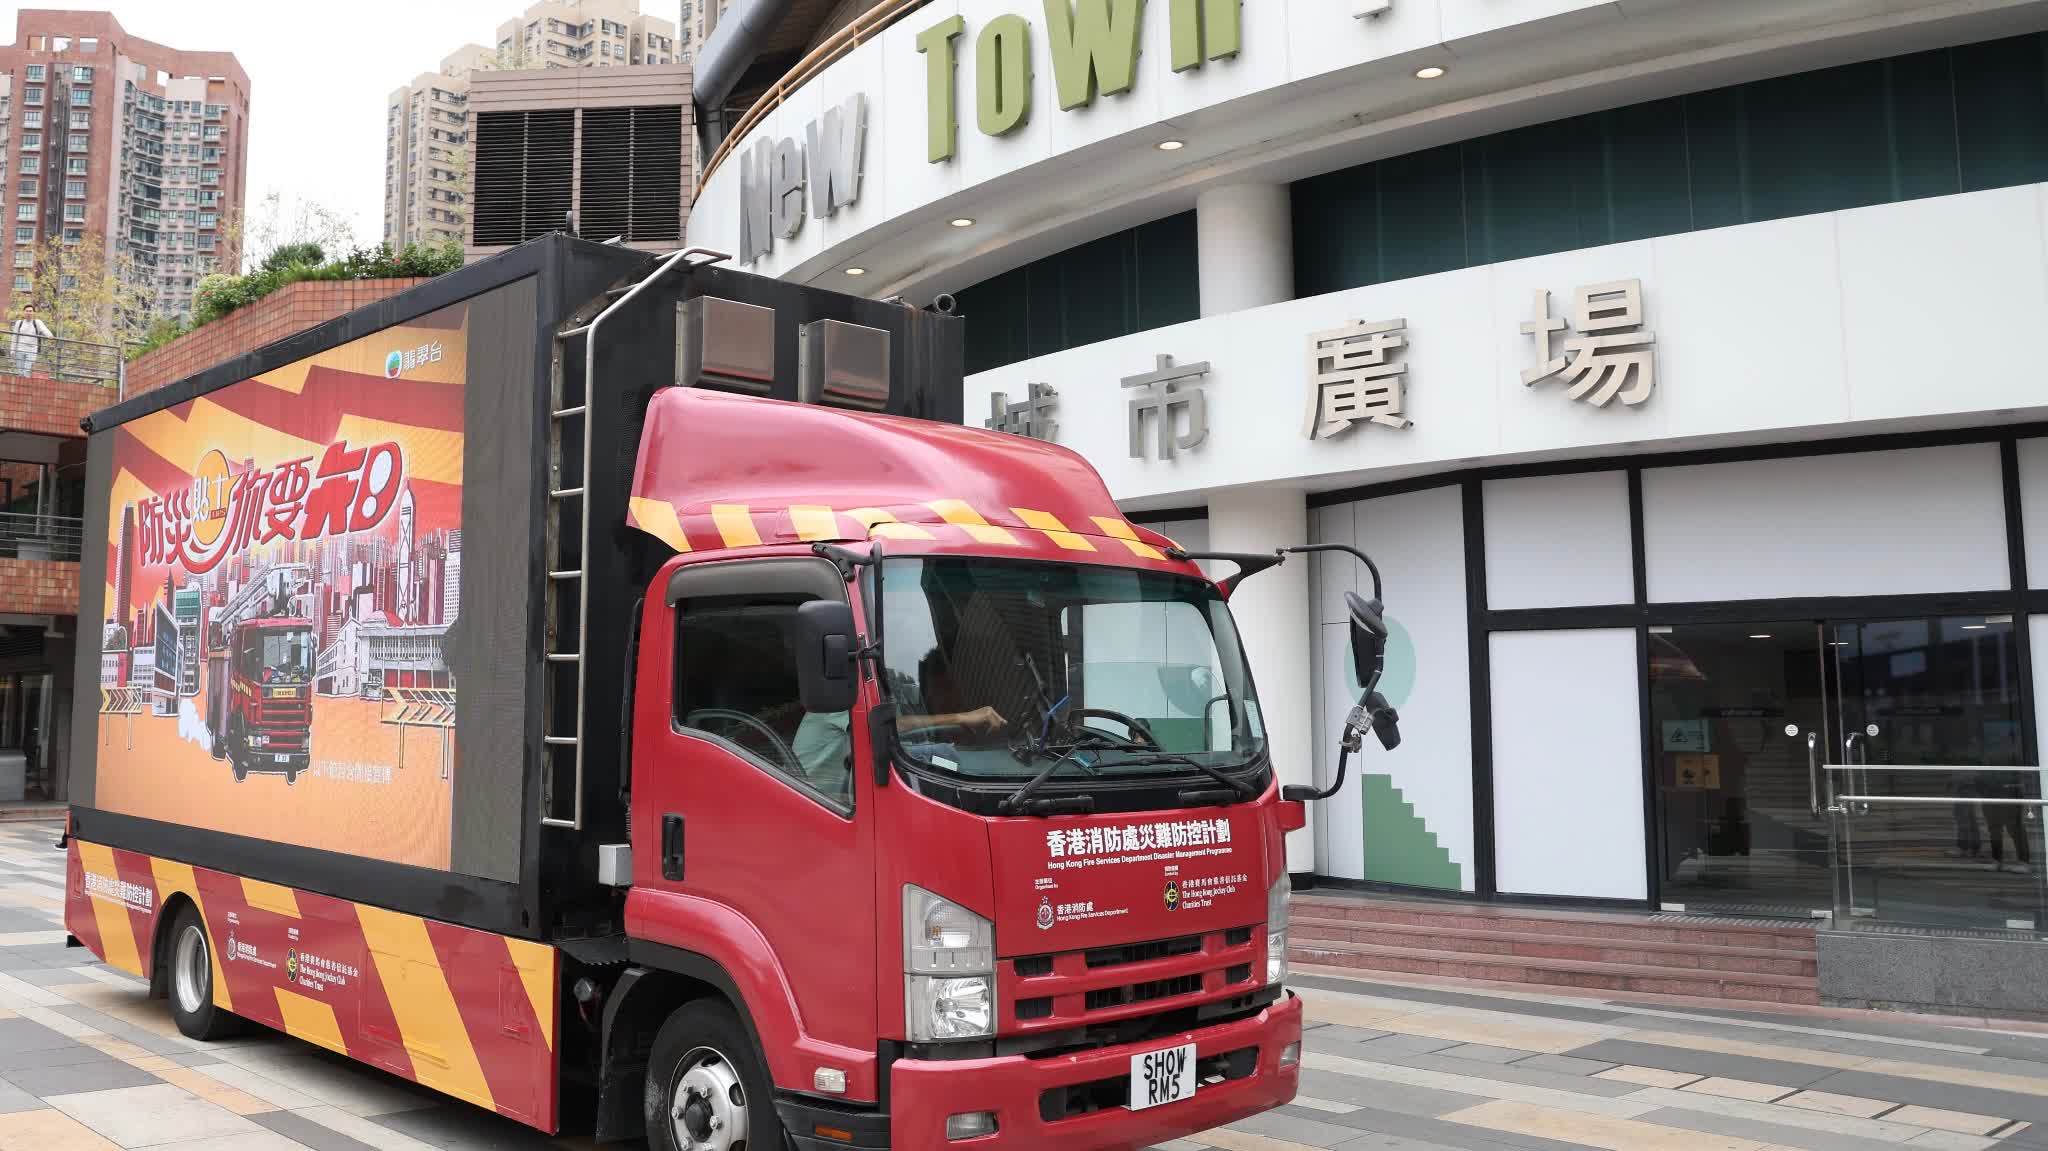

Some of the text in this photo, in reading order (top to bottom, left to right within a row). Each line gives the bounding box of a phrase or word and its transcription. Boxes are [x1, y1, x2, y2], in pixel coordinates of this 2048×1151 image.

[1046, 818, 1231, 857] 香港消防處災難防控計劃
[1047, 861, 1065, 870] Hong
[1066, 859, 1082, 868] Kong
[1083, 858, 1095, 866] Fire
[1096, 856, 1120, 865] Services
[1121, 853, 1153, 864] Department
[1153, 851, 1175, 860] Disaster
[1175, 849, 1206, 858] Management
[1182, 890, 1190, 899] The
[1190, 889, 1202, 899] Hong
[1056, 901, 1094, 915] 香港消防處
[1200, 899, 1212, 908] Trust
[1088, 910, 1104, 918] Services
[1104, 908, 1129, 916] Department
[1144, 1048, 1186, 1080] SHOW
[1149, 1074, 1181, 1105] RM5
